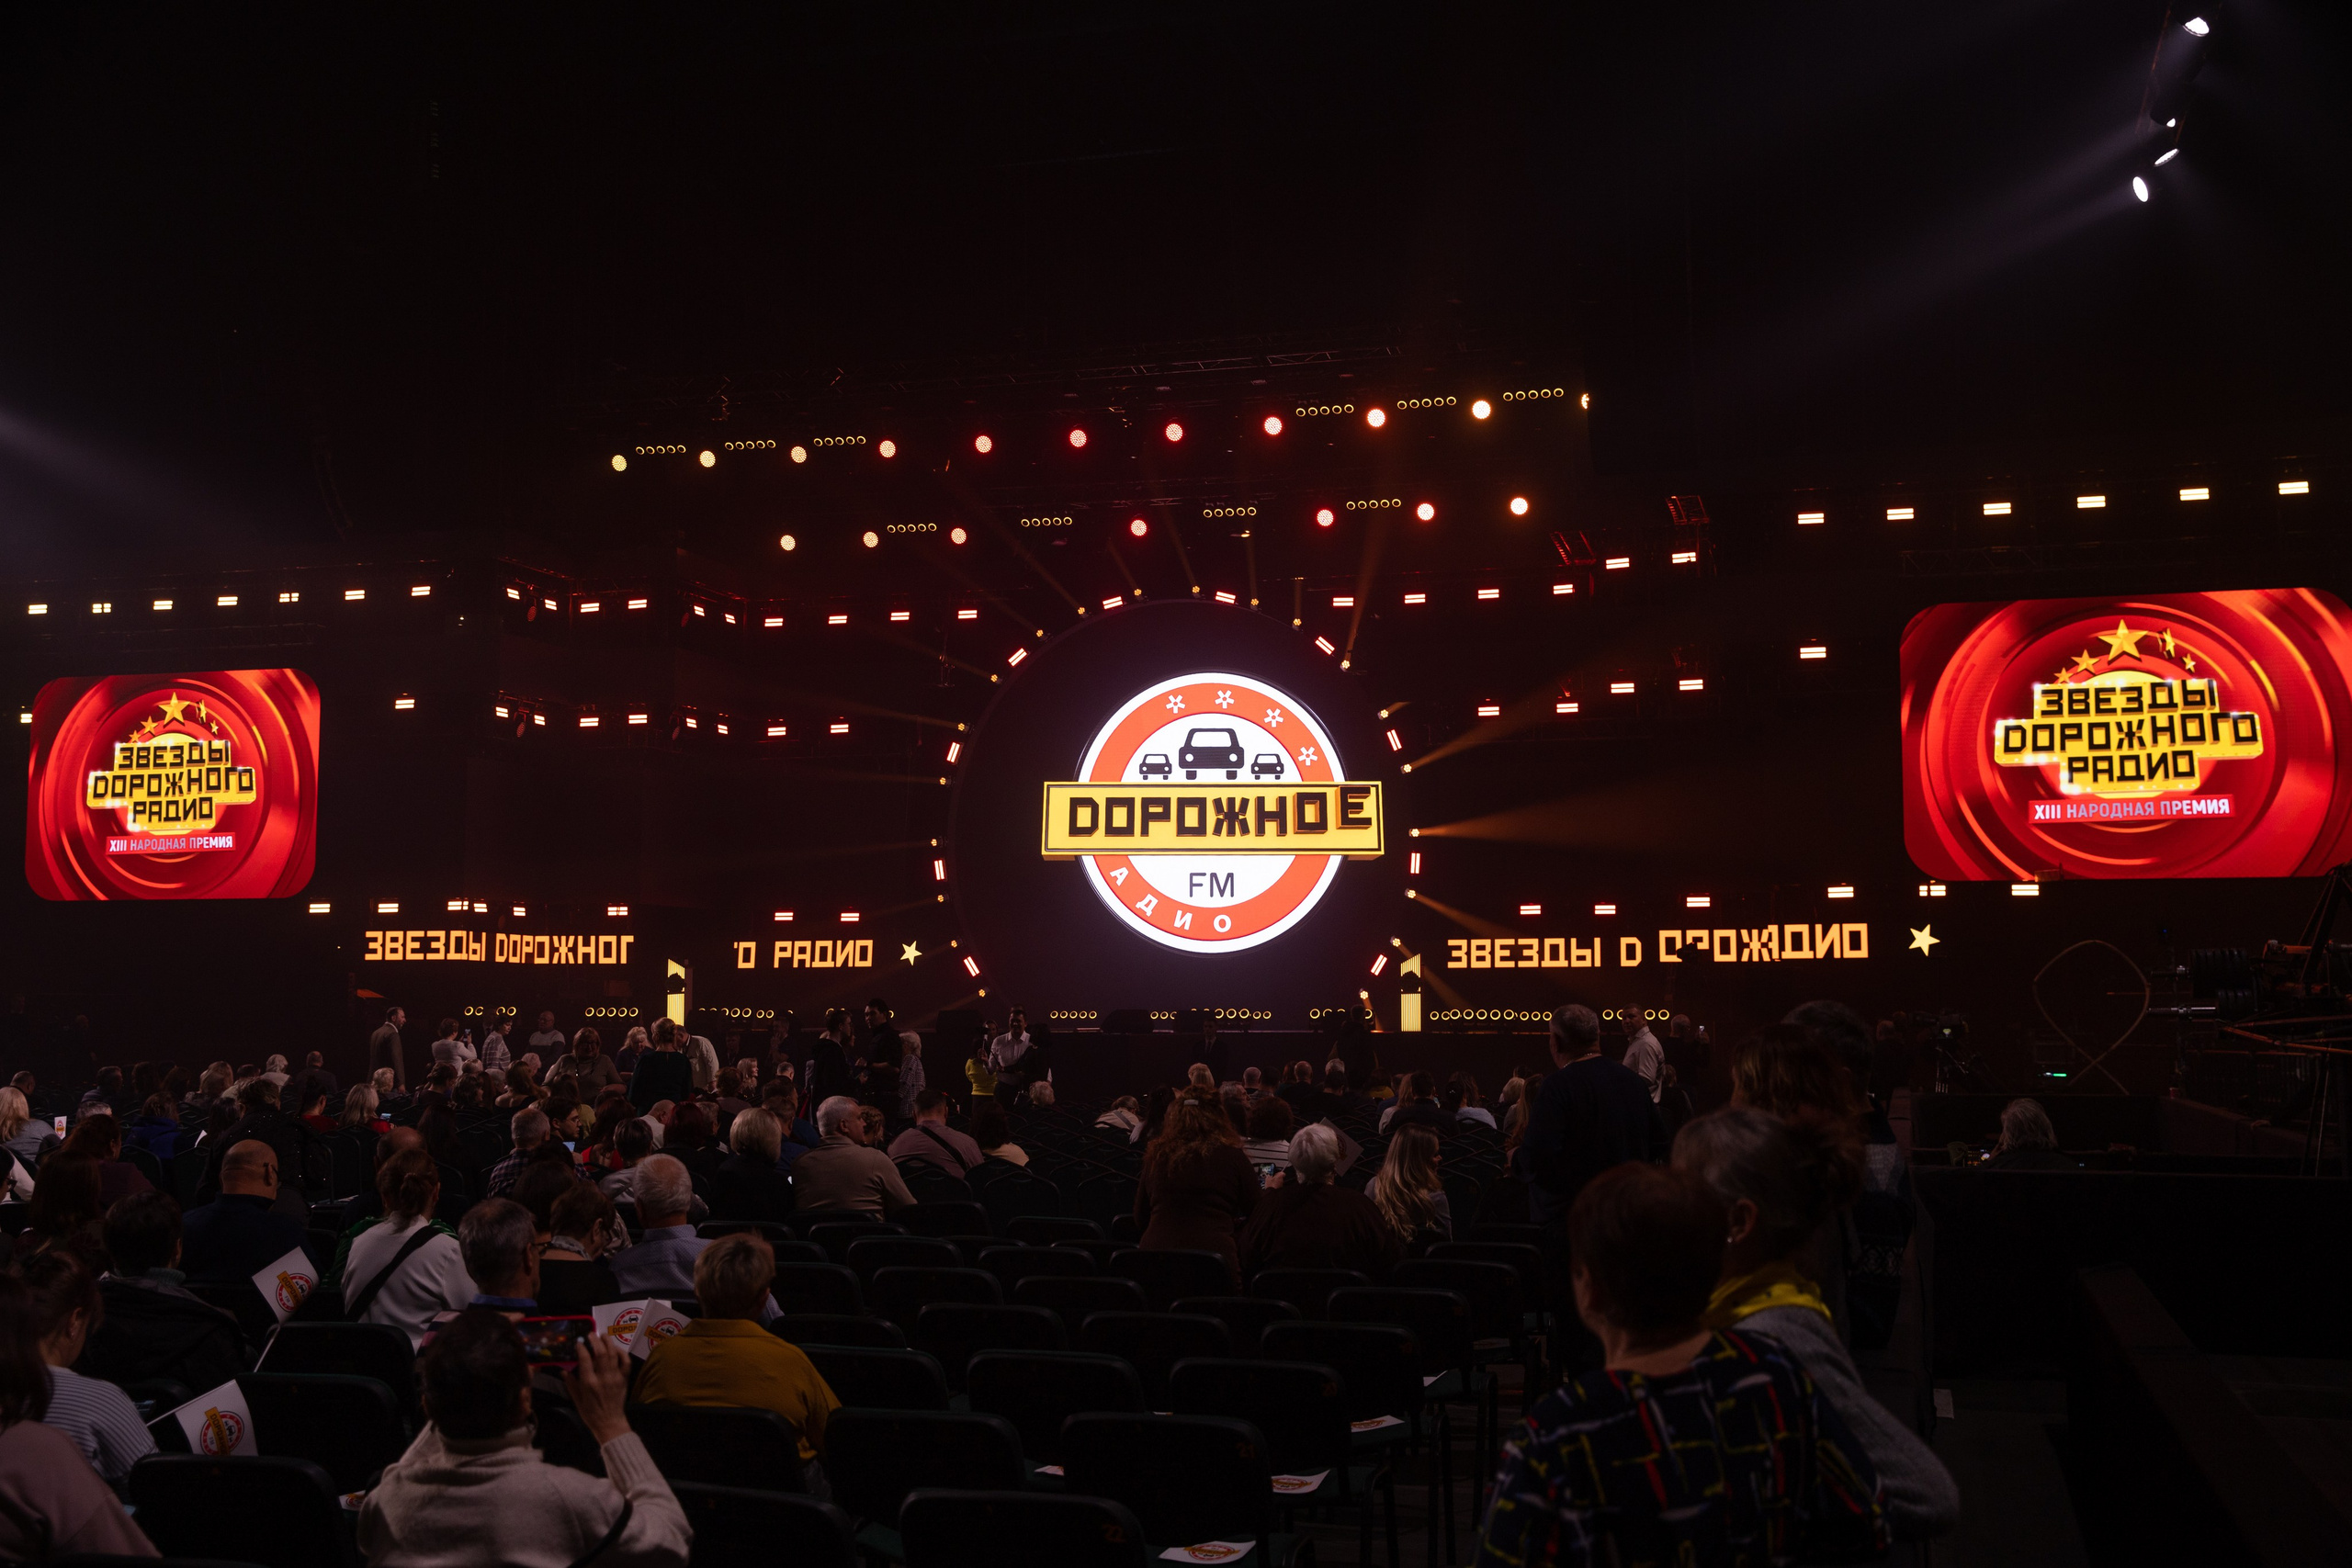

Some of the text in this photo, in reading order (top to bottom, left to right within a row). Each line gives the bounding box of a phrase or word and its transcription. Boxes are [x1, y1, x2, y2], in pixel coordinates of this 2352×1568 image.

[2041, 678, 2215, 716] ЗВЕЗДЫ
[119, 740, 229, 769] ЗВЕЗДЫ
[2068, 750, 2196, 784] РАДИО
[132, 796, 213, 823] РАДИО
[2034, 798, 2231, 820] XIII НАРОДНАЯ ПРЕМИЯ
[109, 836, 233, 852] XIII НАРОДНАЯ ПРЕМИЯ
[1189, 872, 1235, 898] FM
[365, 930, 487, 962] ЗВЕЗДЫ
[774, 939, 874, 969] РАДИО
[1447, 937, 1601, 969] ЗВЕЗДЫ
